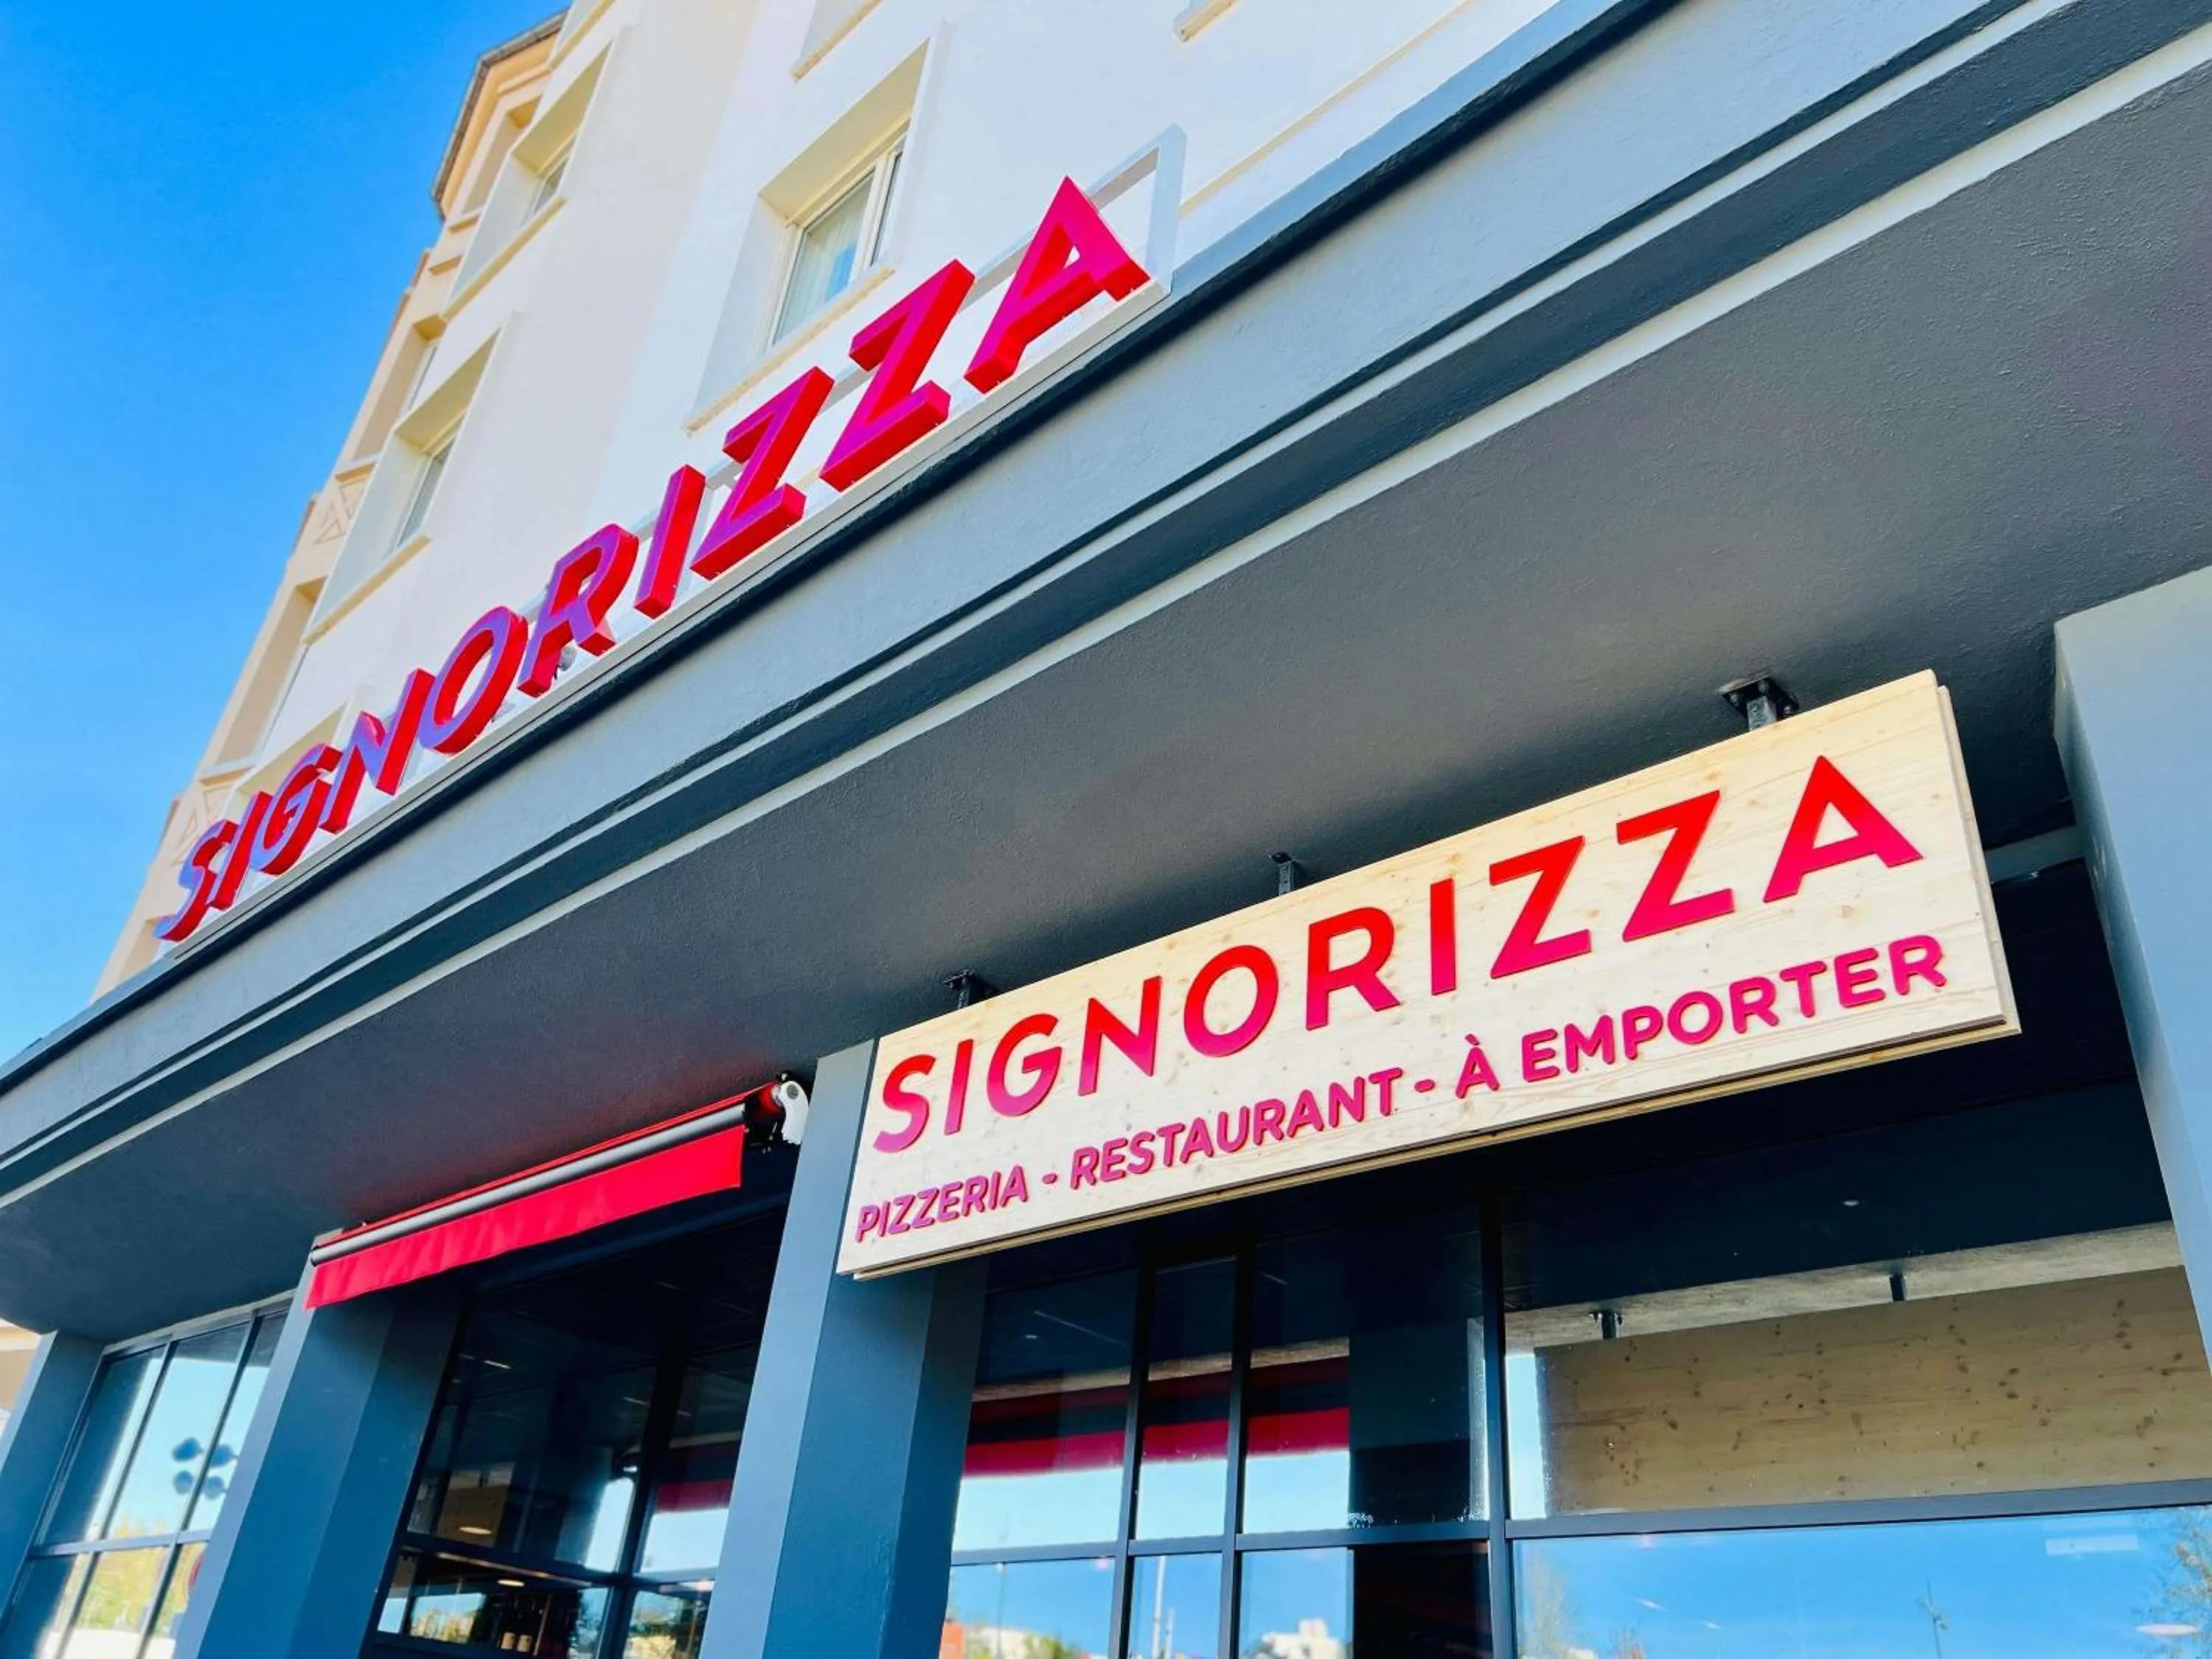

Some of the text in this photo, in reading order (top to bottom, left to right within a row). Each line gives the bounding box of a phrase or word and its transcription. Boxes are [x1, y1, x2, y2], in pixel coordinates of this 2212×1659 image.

[156, 176, 1151, 942] SIGNORIZZA
[855, 1164, 1029, 1242] PIZZERIA
[1070, 1067, 1404, 1190] RESTAURANT
[1455, 1034, 1500, 1099] À
[1521, 934, 1947, 1084] EMPORTER
[873, 755, 1923, 1153] SIGNORIZZA
